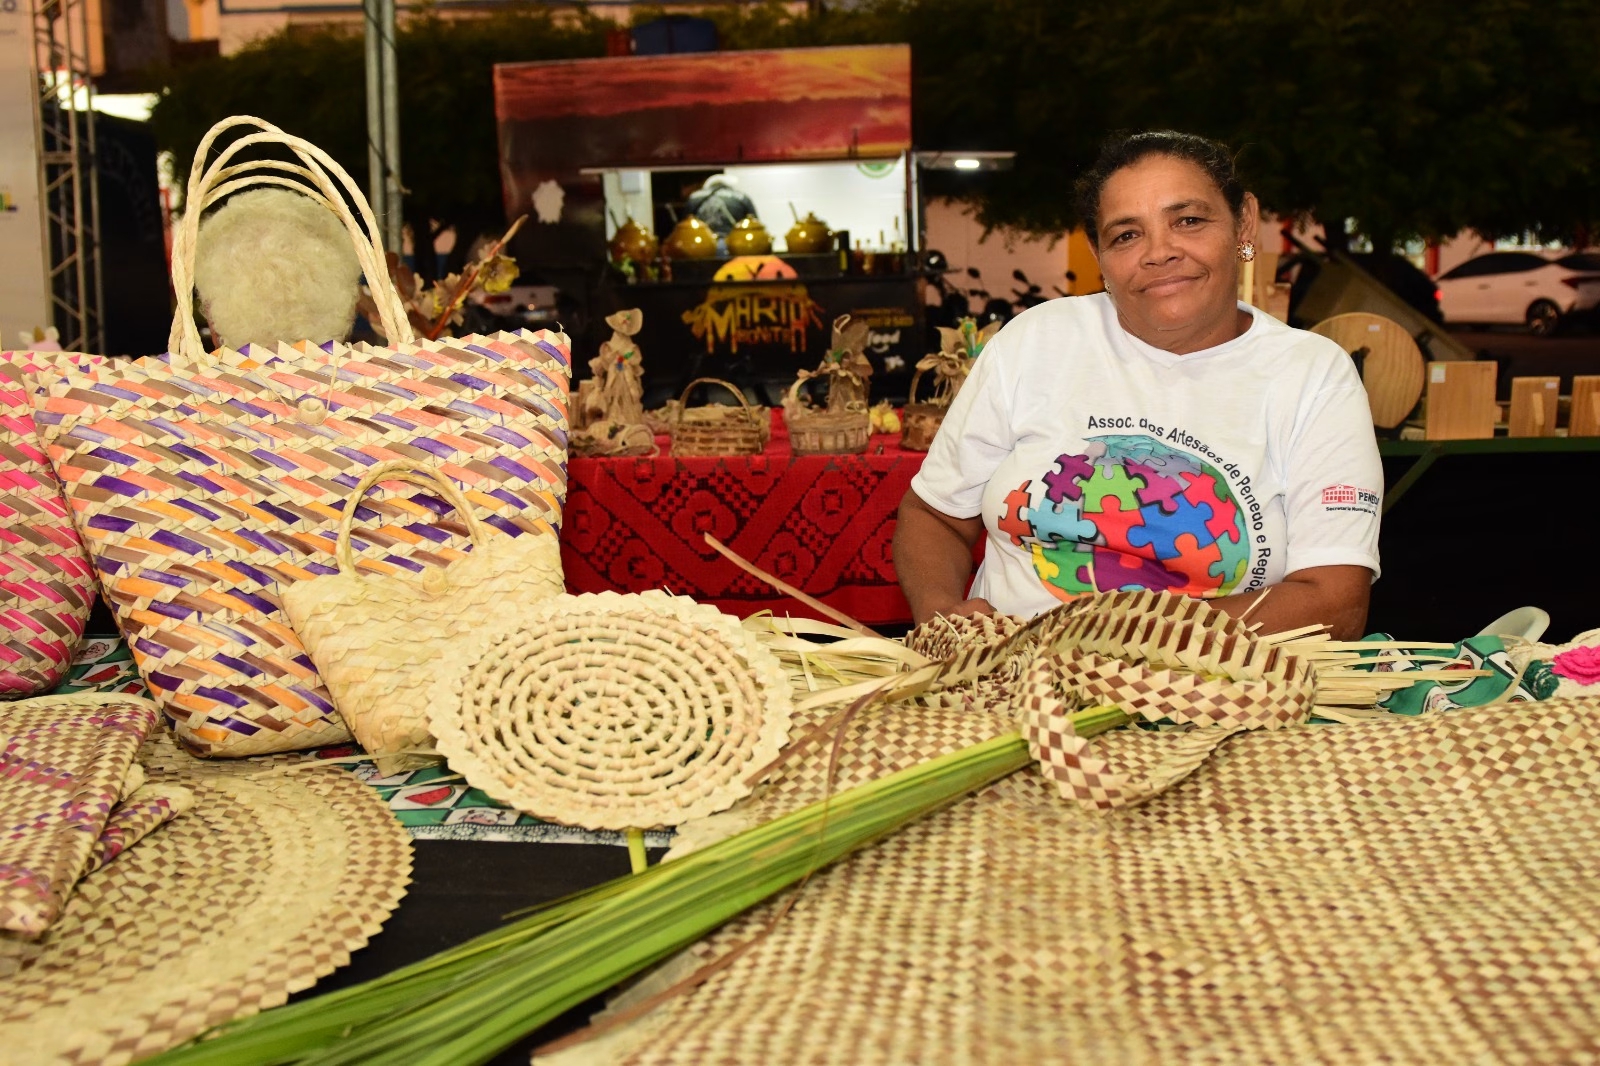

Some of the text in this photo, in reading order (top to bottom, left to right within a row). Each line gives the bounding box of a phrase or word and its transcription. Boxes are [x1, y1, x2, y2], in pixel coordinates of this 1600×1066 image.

[1087, 415, 1135, 430] Assoc.
[1166, 427, 1224, 464] Artesãos
[1223, 463, 1241, 480] de
[1236, 475, 1263, 531] Penedo
[1256, 534, 1267, 544] e
